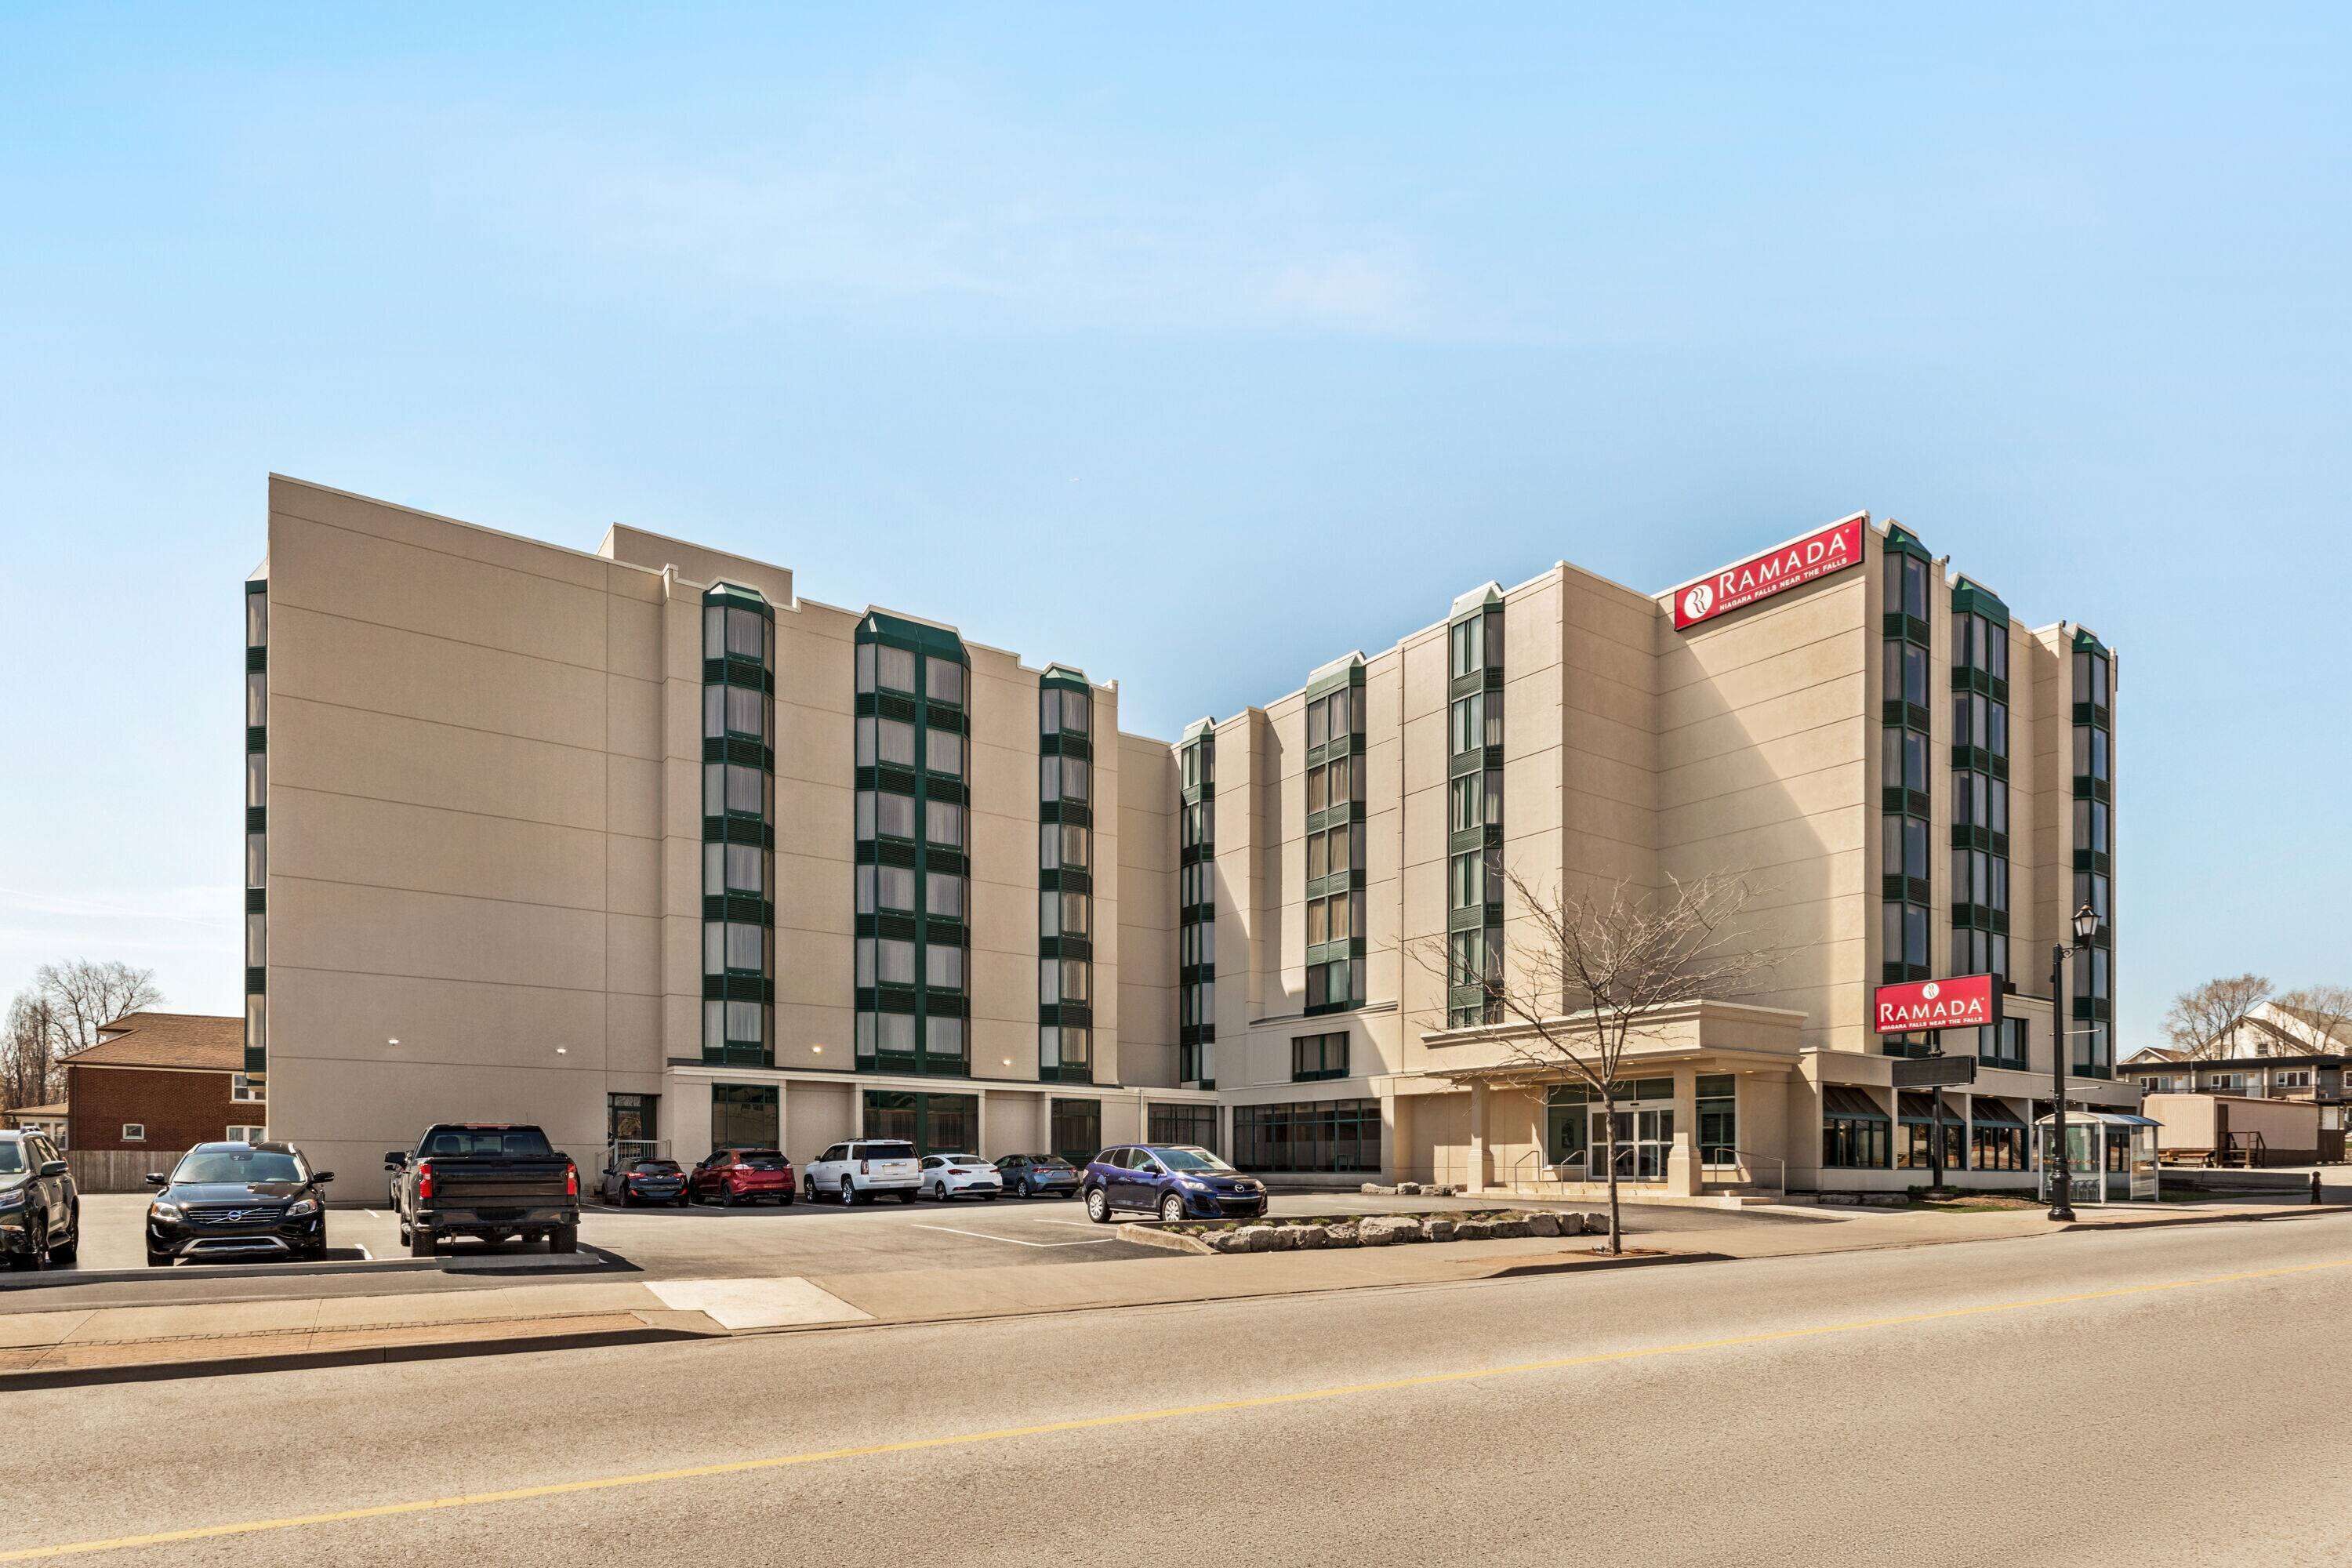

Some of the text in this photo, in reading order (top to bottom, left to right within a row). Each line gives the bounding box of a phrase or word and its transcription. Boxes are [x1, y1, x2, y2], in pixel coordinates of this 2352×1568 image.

[1719, 532, 1846, 599] RAMADA
[1719, 557, 1847, 612] NIAGARA FALLS NEAR THE FALLS
[1880, 997, 1983, 1022] RAMADA
